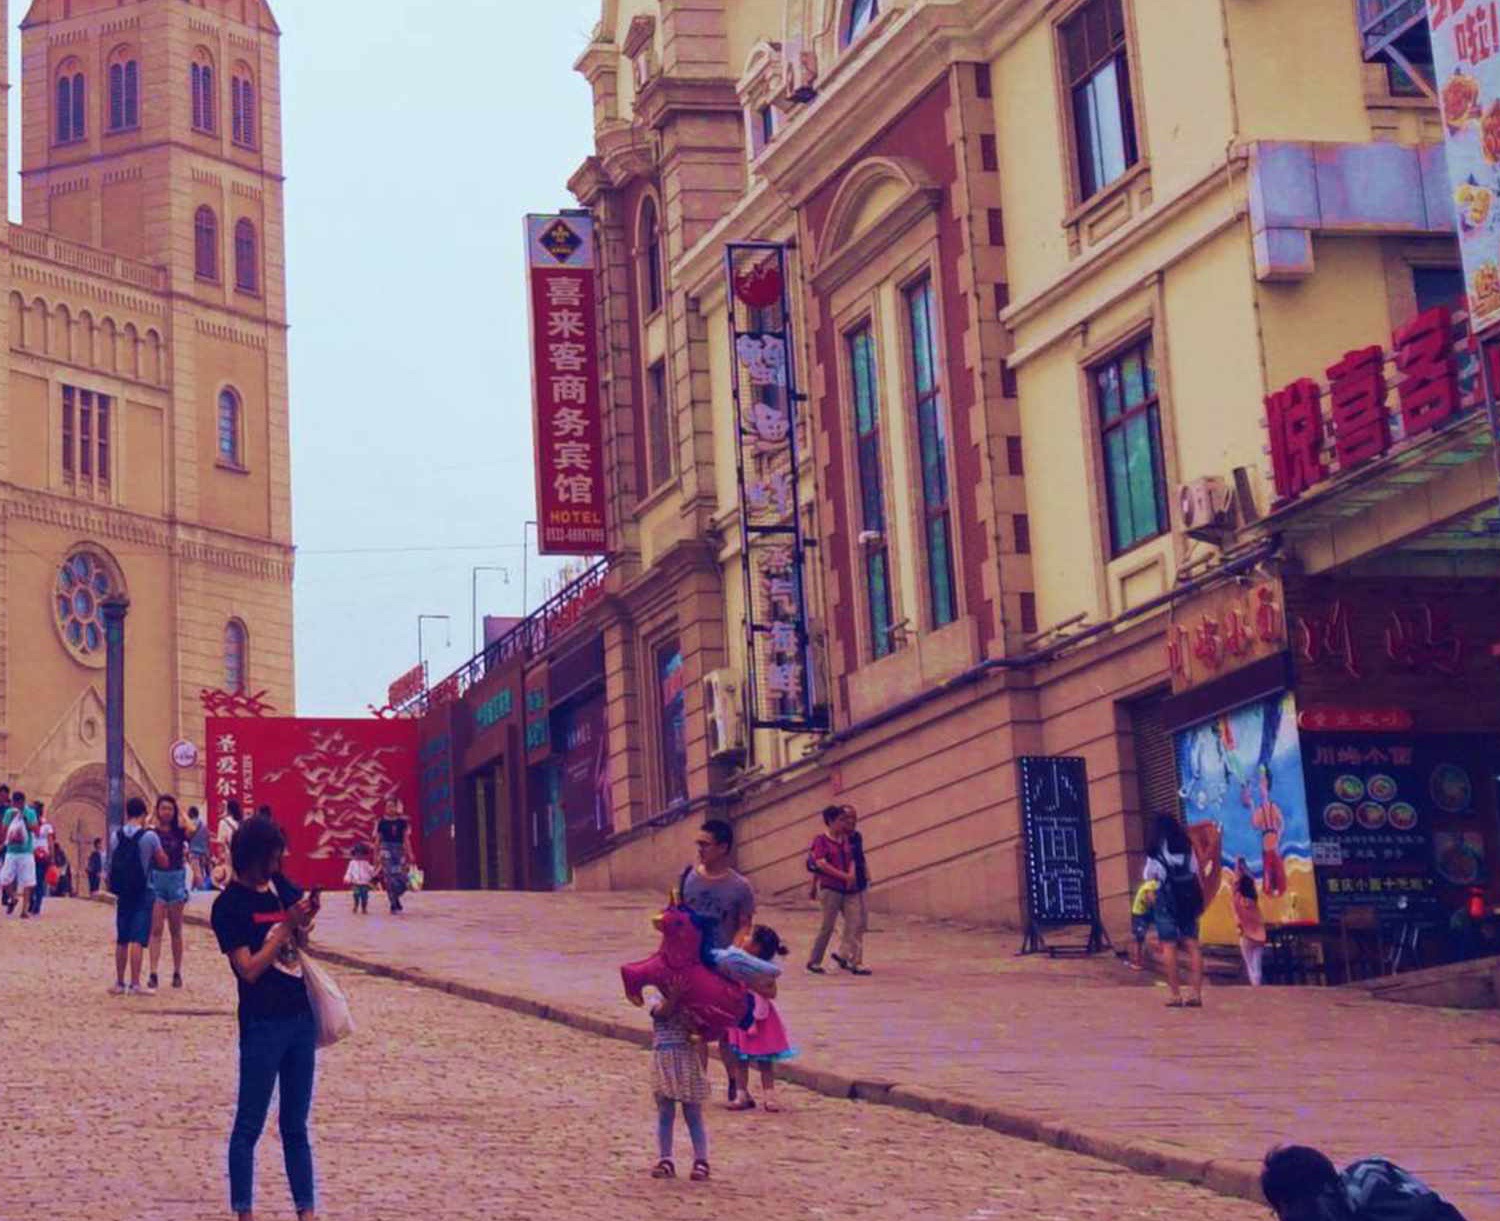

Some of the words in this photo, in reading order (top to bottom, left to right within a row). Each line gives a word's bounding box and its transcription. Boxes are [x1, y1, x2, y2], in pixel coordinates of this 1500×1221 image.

[546, 276, 594, 505] 喜来客商务宾馆
[550, 510, 601, 524] HOTEL
